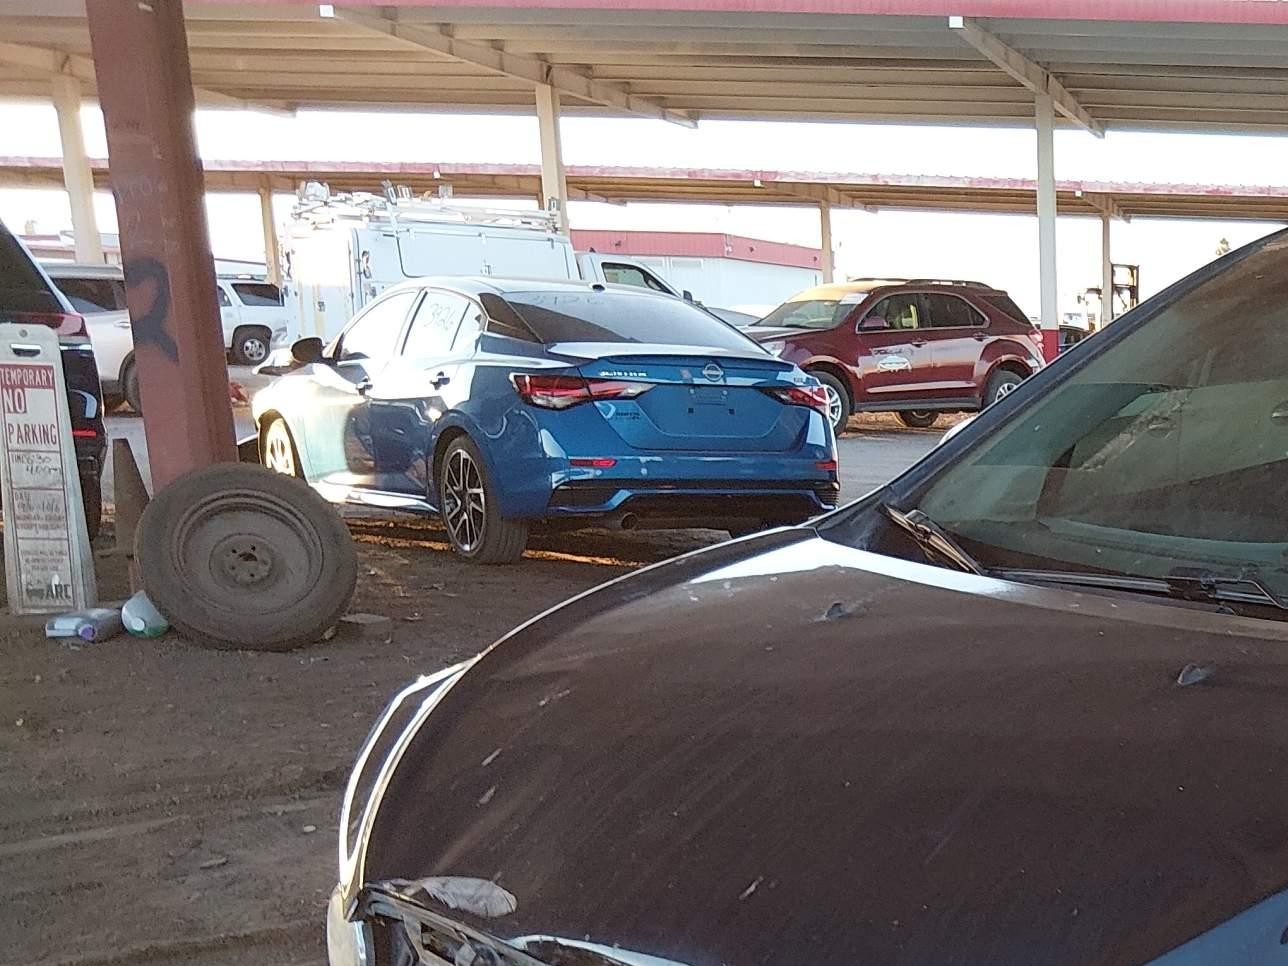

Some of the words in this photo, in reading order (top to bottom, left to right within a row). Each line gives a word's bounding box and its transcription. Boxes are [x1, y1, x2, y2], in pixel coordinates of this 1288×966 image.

[0, 367, 54, 387] TEMPORARY
[2, 388, 26, 413] NO
[7, 423, 58, 445] PARKING
